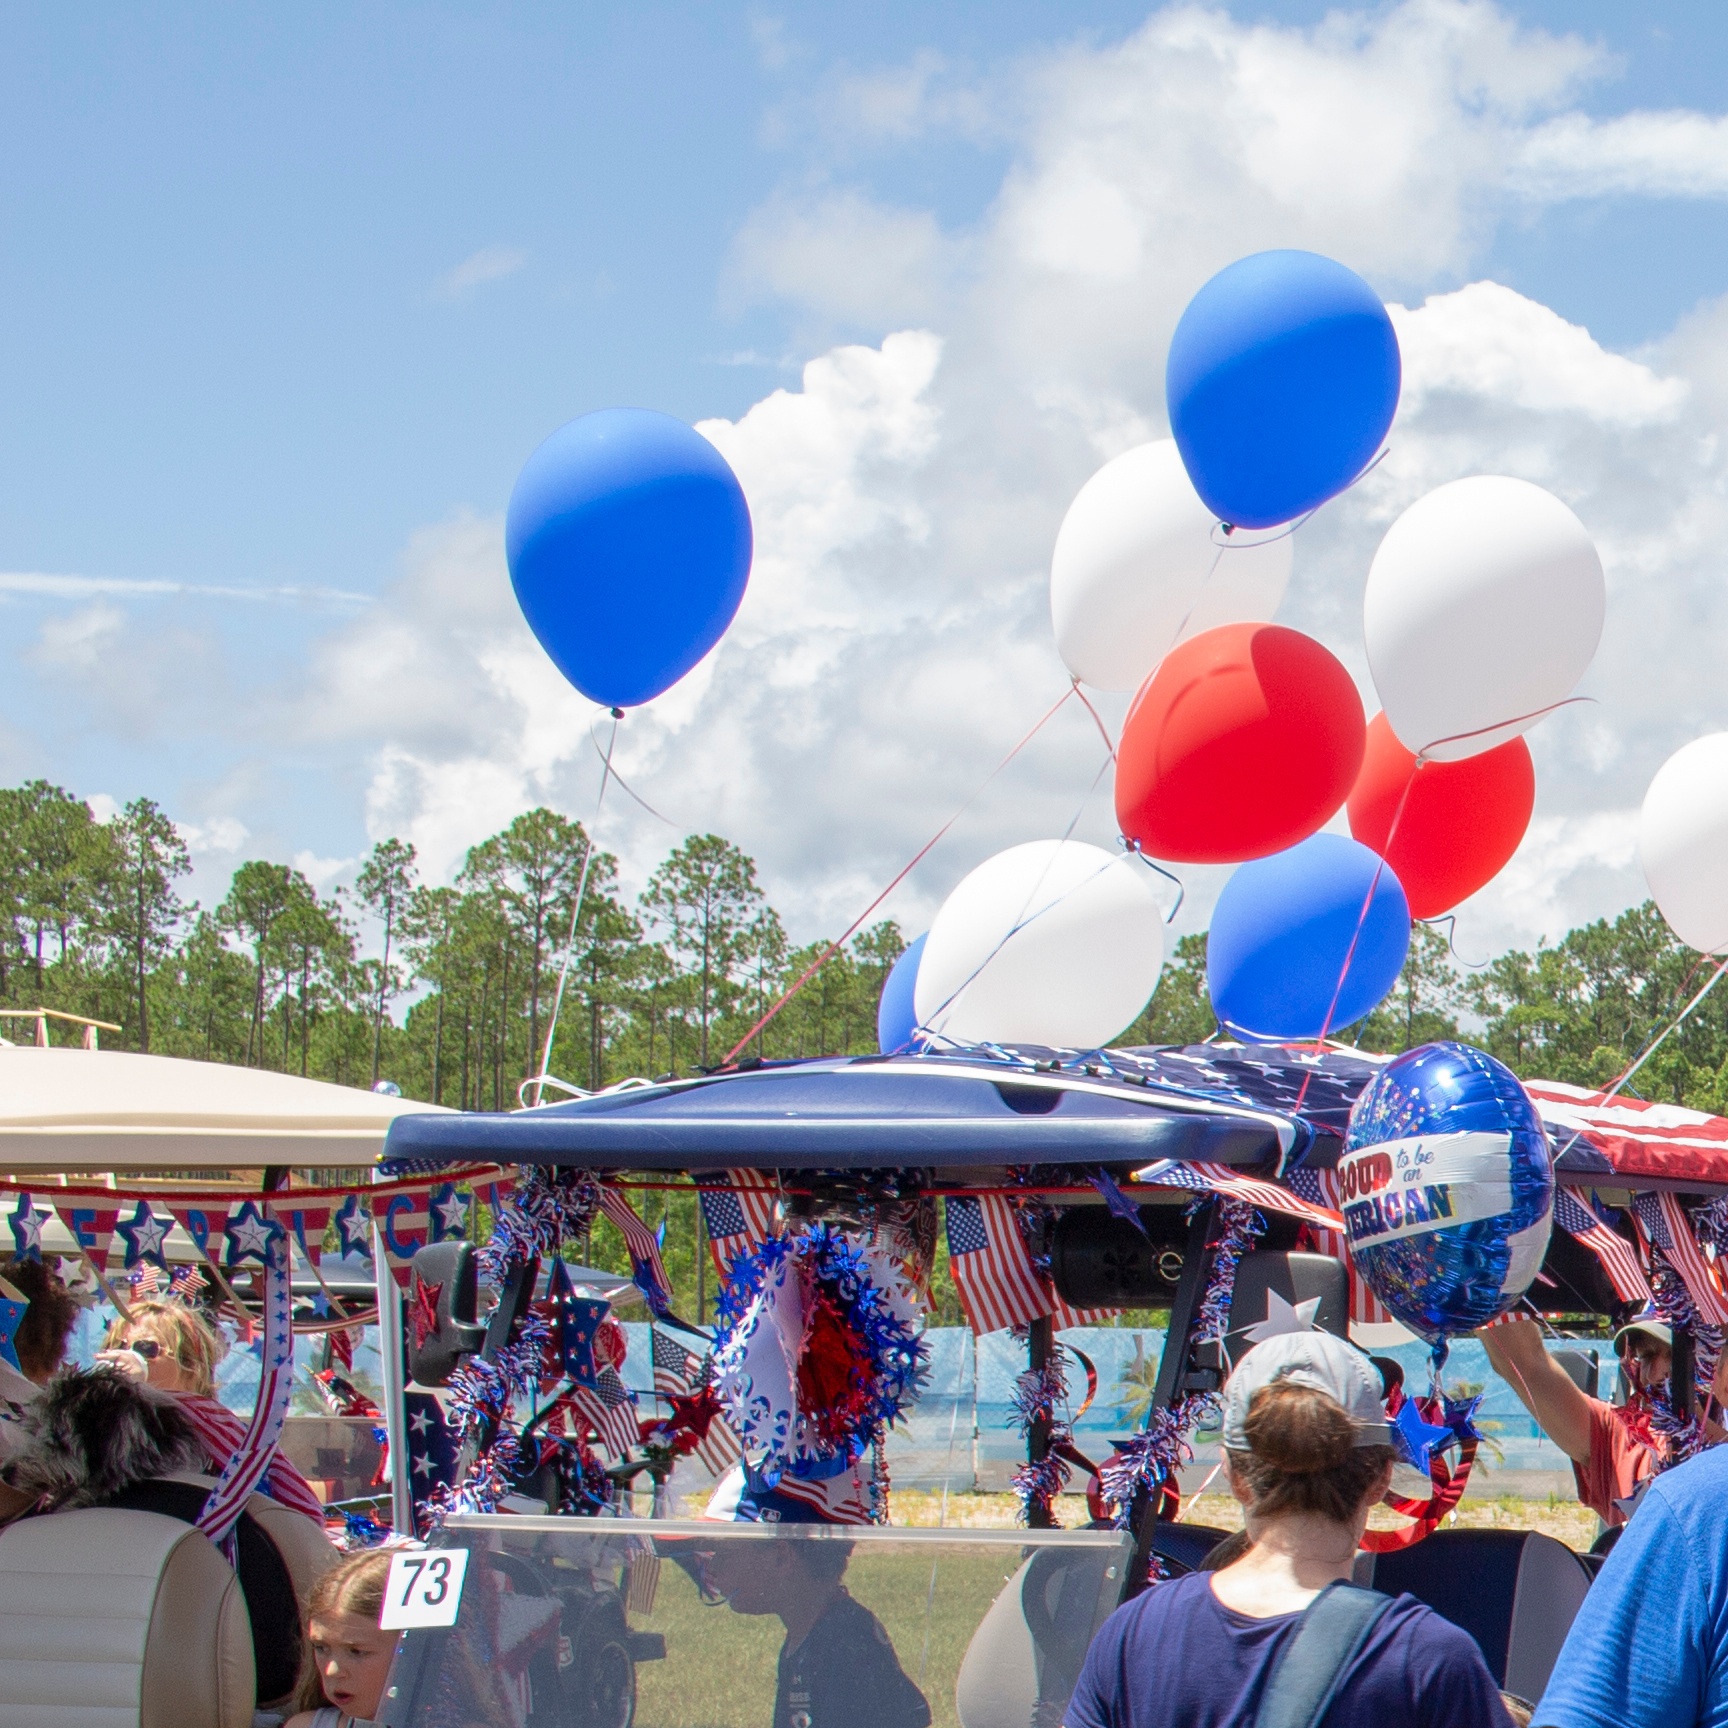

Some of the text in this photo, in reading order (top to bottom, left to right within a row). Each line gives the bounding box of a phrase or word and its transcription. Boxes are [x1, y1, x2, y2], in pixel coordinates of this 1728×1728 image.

[1338, 1143, 1434, 1203] ROUD to be
[1403, 1169, 1423, 1183] an
[401, 1557, 452, 1607] 73
